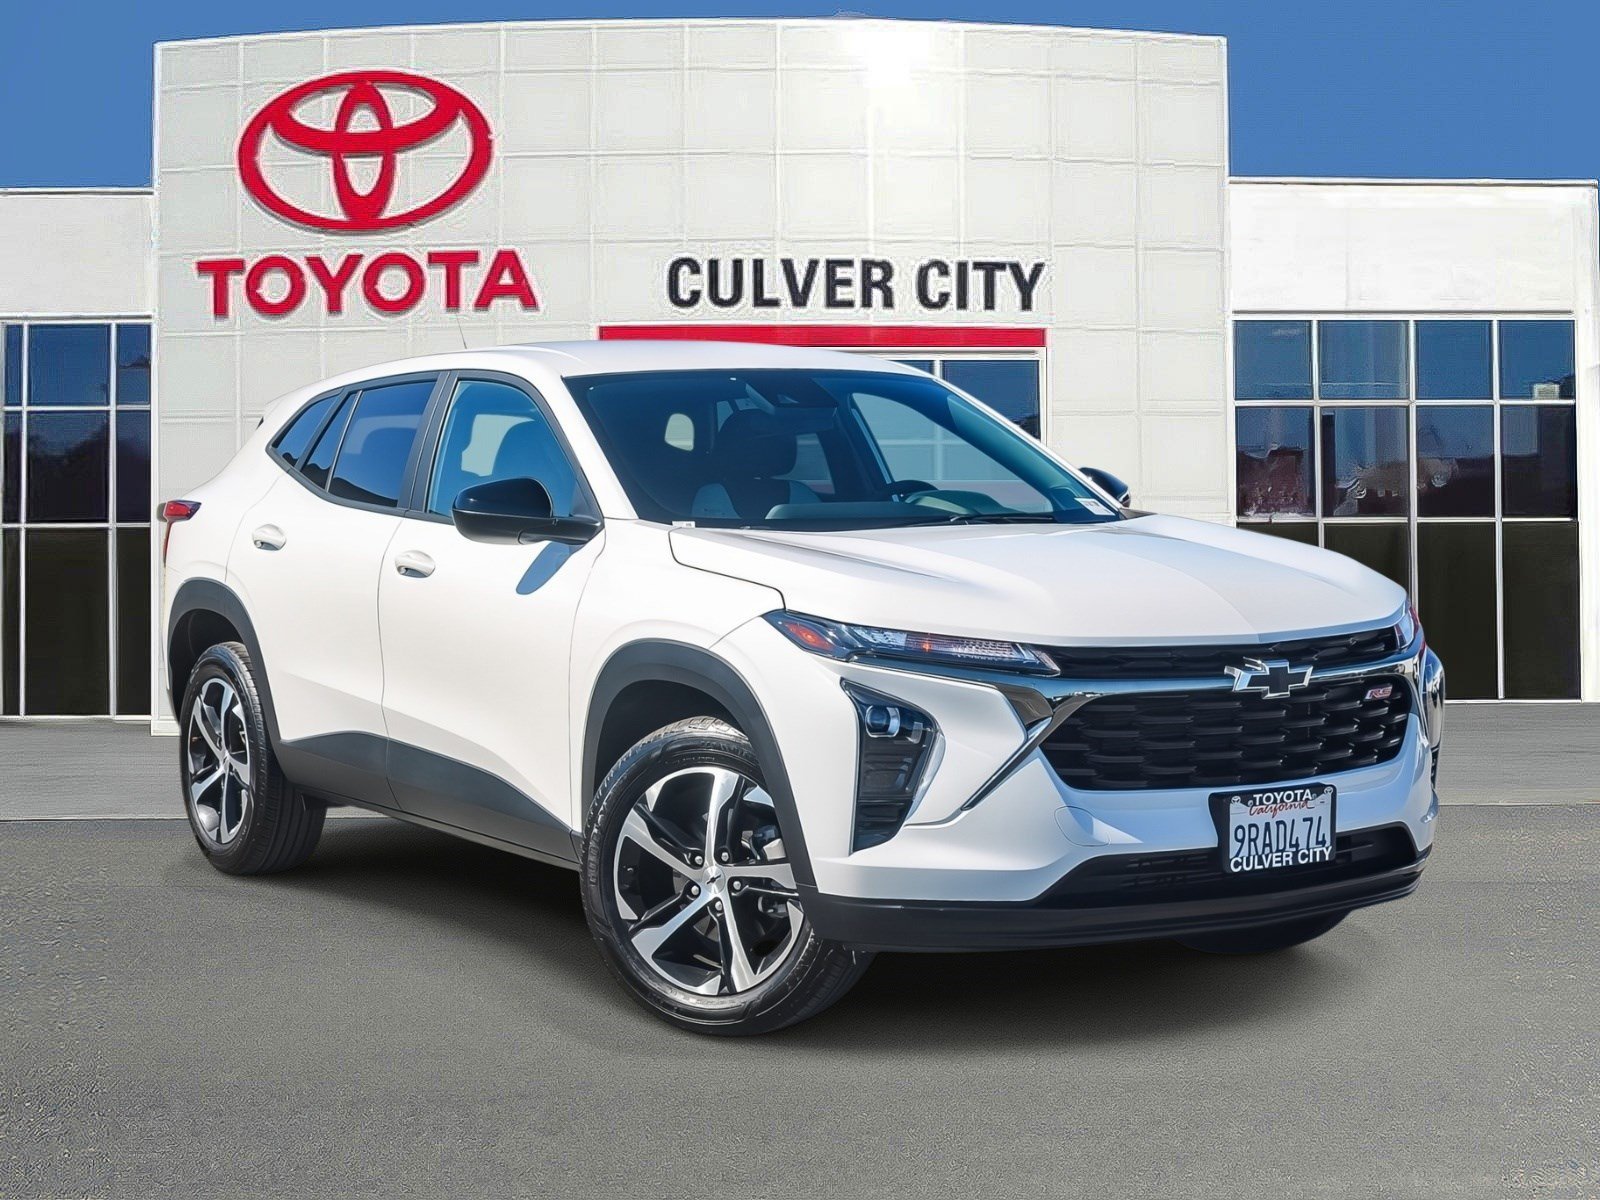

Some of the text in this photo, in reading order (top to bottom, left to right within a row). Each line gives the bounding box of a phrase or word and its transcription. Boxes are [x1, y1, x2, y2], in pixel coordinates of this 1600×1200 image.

[195, 249, 540, 319] TOYOTA
[667, 257, 1045, 311] CULVER CITY
[1364, 685, 1393, 700] RS
[1249, 800, 1315, 818] California
[1253, 789, 1312, 806] TOYOTA
[1234, 816, 1327, 858] 9RAD474
[1230, 846, 1333, 873] CULVER CITY
